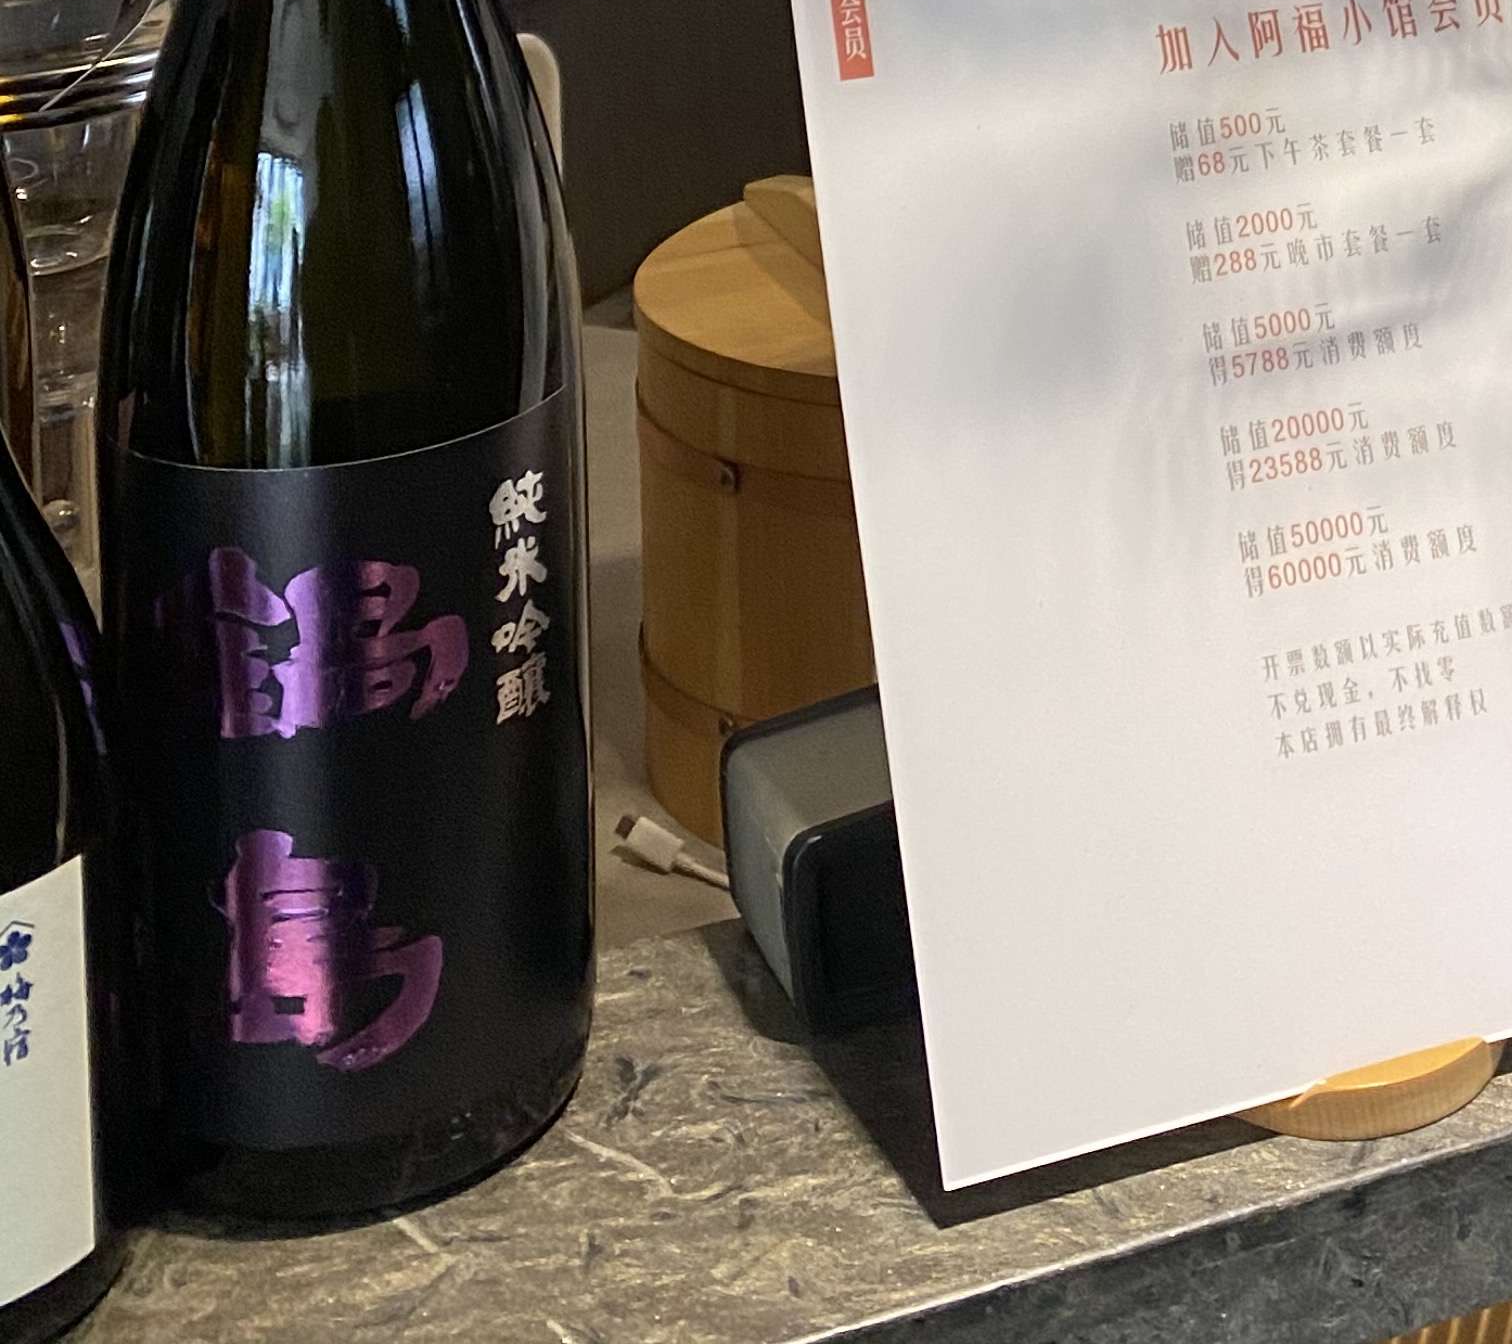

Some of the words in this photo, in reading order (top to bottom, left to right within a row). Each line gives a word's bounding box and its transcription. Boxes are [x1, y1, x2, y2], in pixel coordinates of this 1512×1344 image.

[1169, 108, 1286, 151] 储值500元
[1173, 116, 1436, 184] 赠68元下午茶套餐一套
[1185, 203, 1318, 251] 储值2000元
[1189, 216, 1442, 285] 赠288元晚市套餐一套
[1202, 303, 1336, 353] 储值5000元
[1208, 323, 1423, 386] 得5788元消费额度
[1219, 402, 1369, 457] 储值20000元
[1226, 421, 1457, 492] 得23588元消费额度
[1238, 505, 1389, 564] 储值50000元
[1244, 524, 1478, 598] 得60000元消费额度
[1275, 695, 1488, 759] 本店拥有最终解释权
